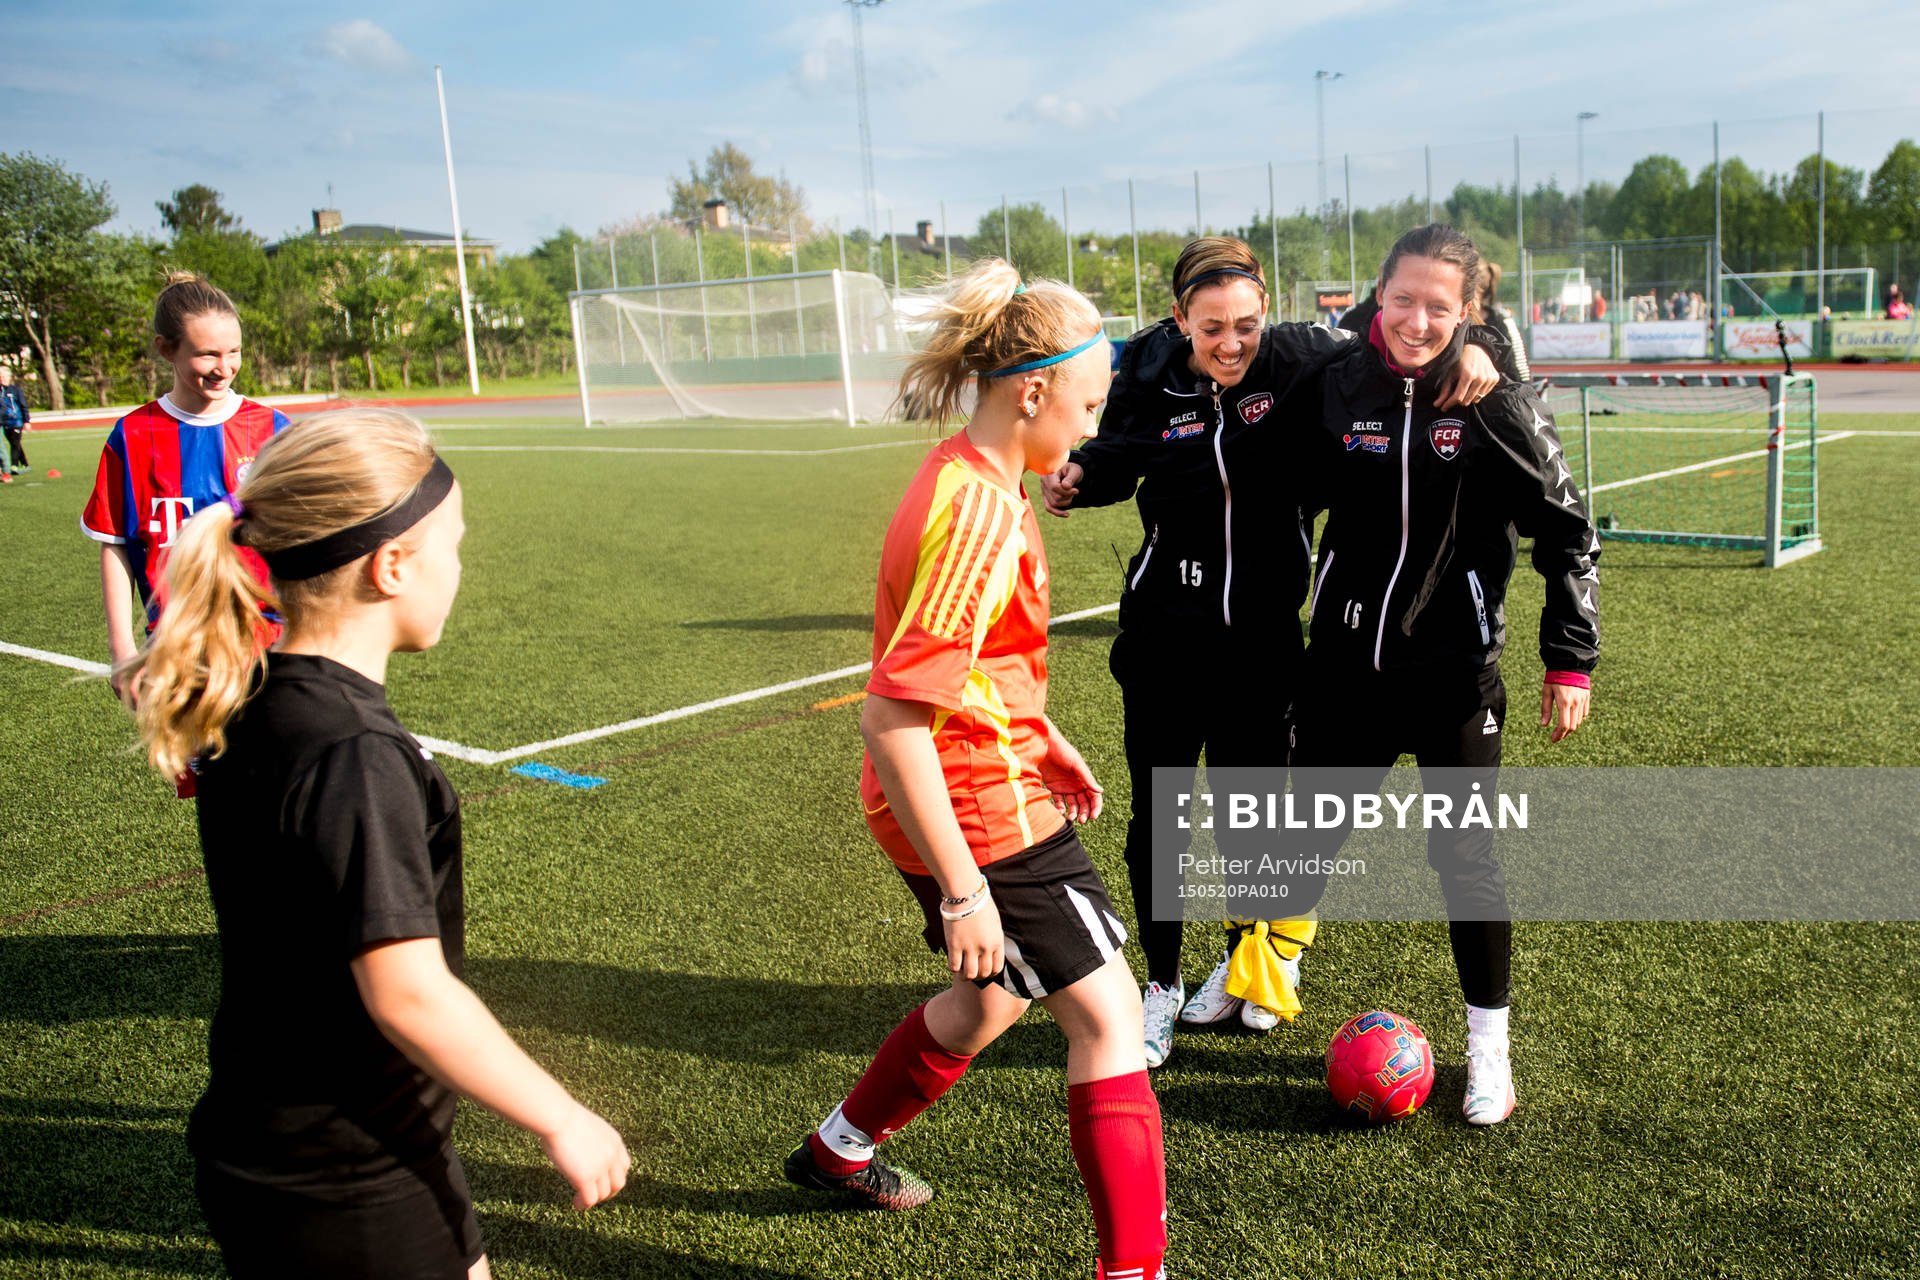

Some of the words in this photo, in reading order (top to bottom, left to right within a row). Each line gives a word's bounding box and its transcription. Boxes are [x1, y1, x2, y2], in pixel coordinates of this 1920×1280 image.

[1245, 400, 1269, 417] FCR
[1170, 411, 1197, 426] SELECT
[1352, 422, 1383, 431] SELECT
[1361, 434, 1388, 445] INTER
[1434, 429, 1461, 441] FCR
[1179, 559, 1203, 587] 15
[1343, 599, 1363, 629] 16
